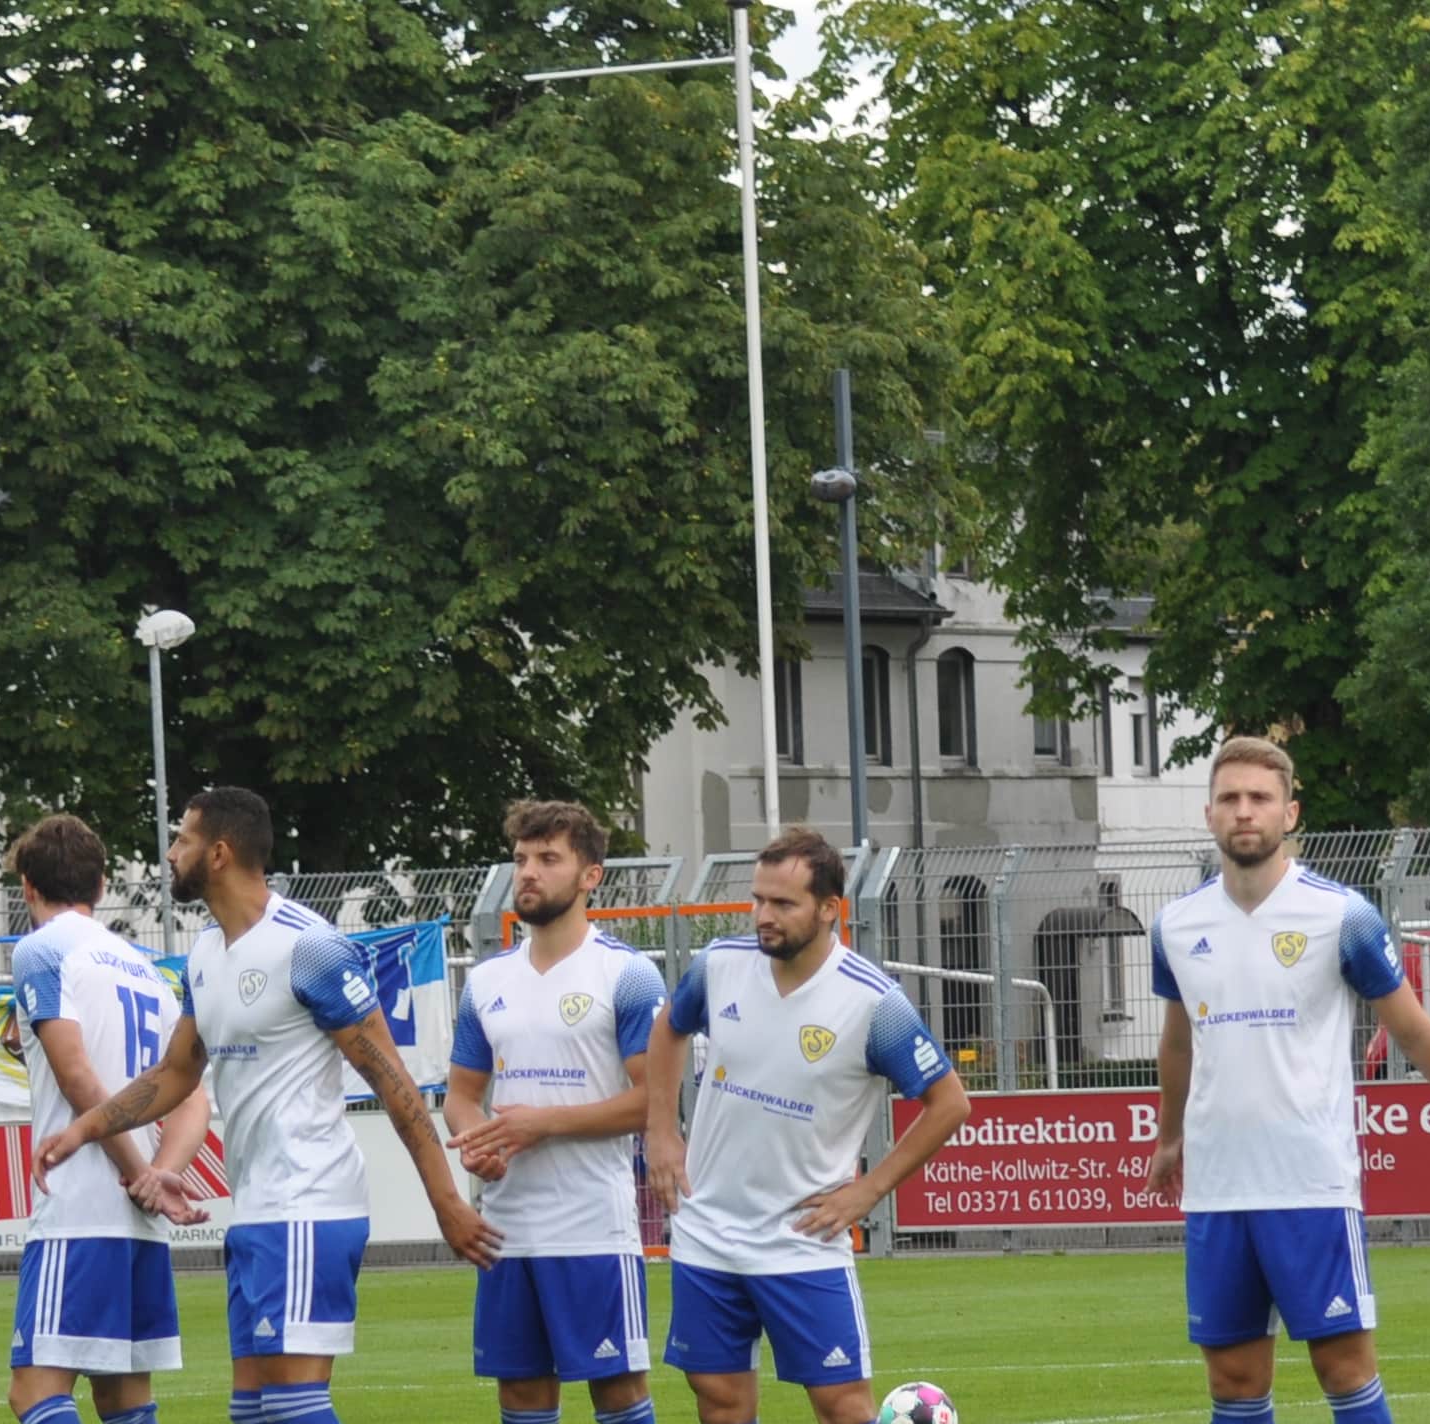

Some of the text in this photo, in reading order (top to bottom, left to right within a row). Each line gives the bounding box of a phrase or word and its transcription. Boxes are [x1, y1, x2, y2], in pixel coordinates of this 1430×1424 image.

[1275, 934, 1306, 957] FSV
[1208, 1008, 1296, 1025] LUCKENWALDER
[803, 1029, 832, 1053] FSV
[504, 1068, 586, 1080] UCKENWALDER
[723, 1081, 814, 1115] LUCKENWALDER
[944, 1115, 1116, 1147] bdirektion
[924, 1158, 1112, 1183] Käthe-Kollwitz-Str.
[925, 1191, 952, 1214] Tel
[957, 1190, 1021, 1213] 03371
[1028, 1187, 1112, 1213] 611039,
